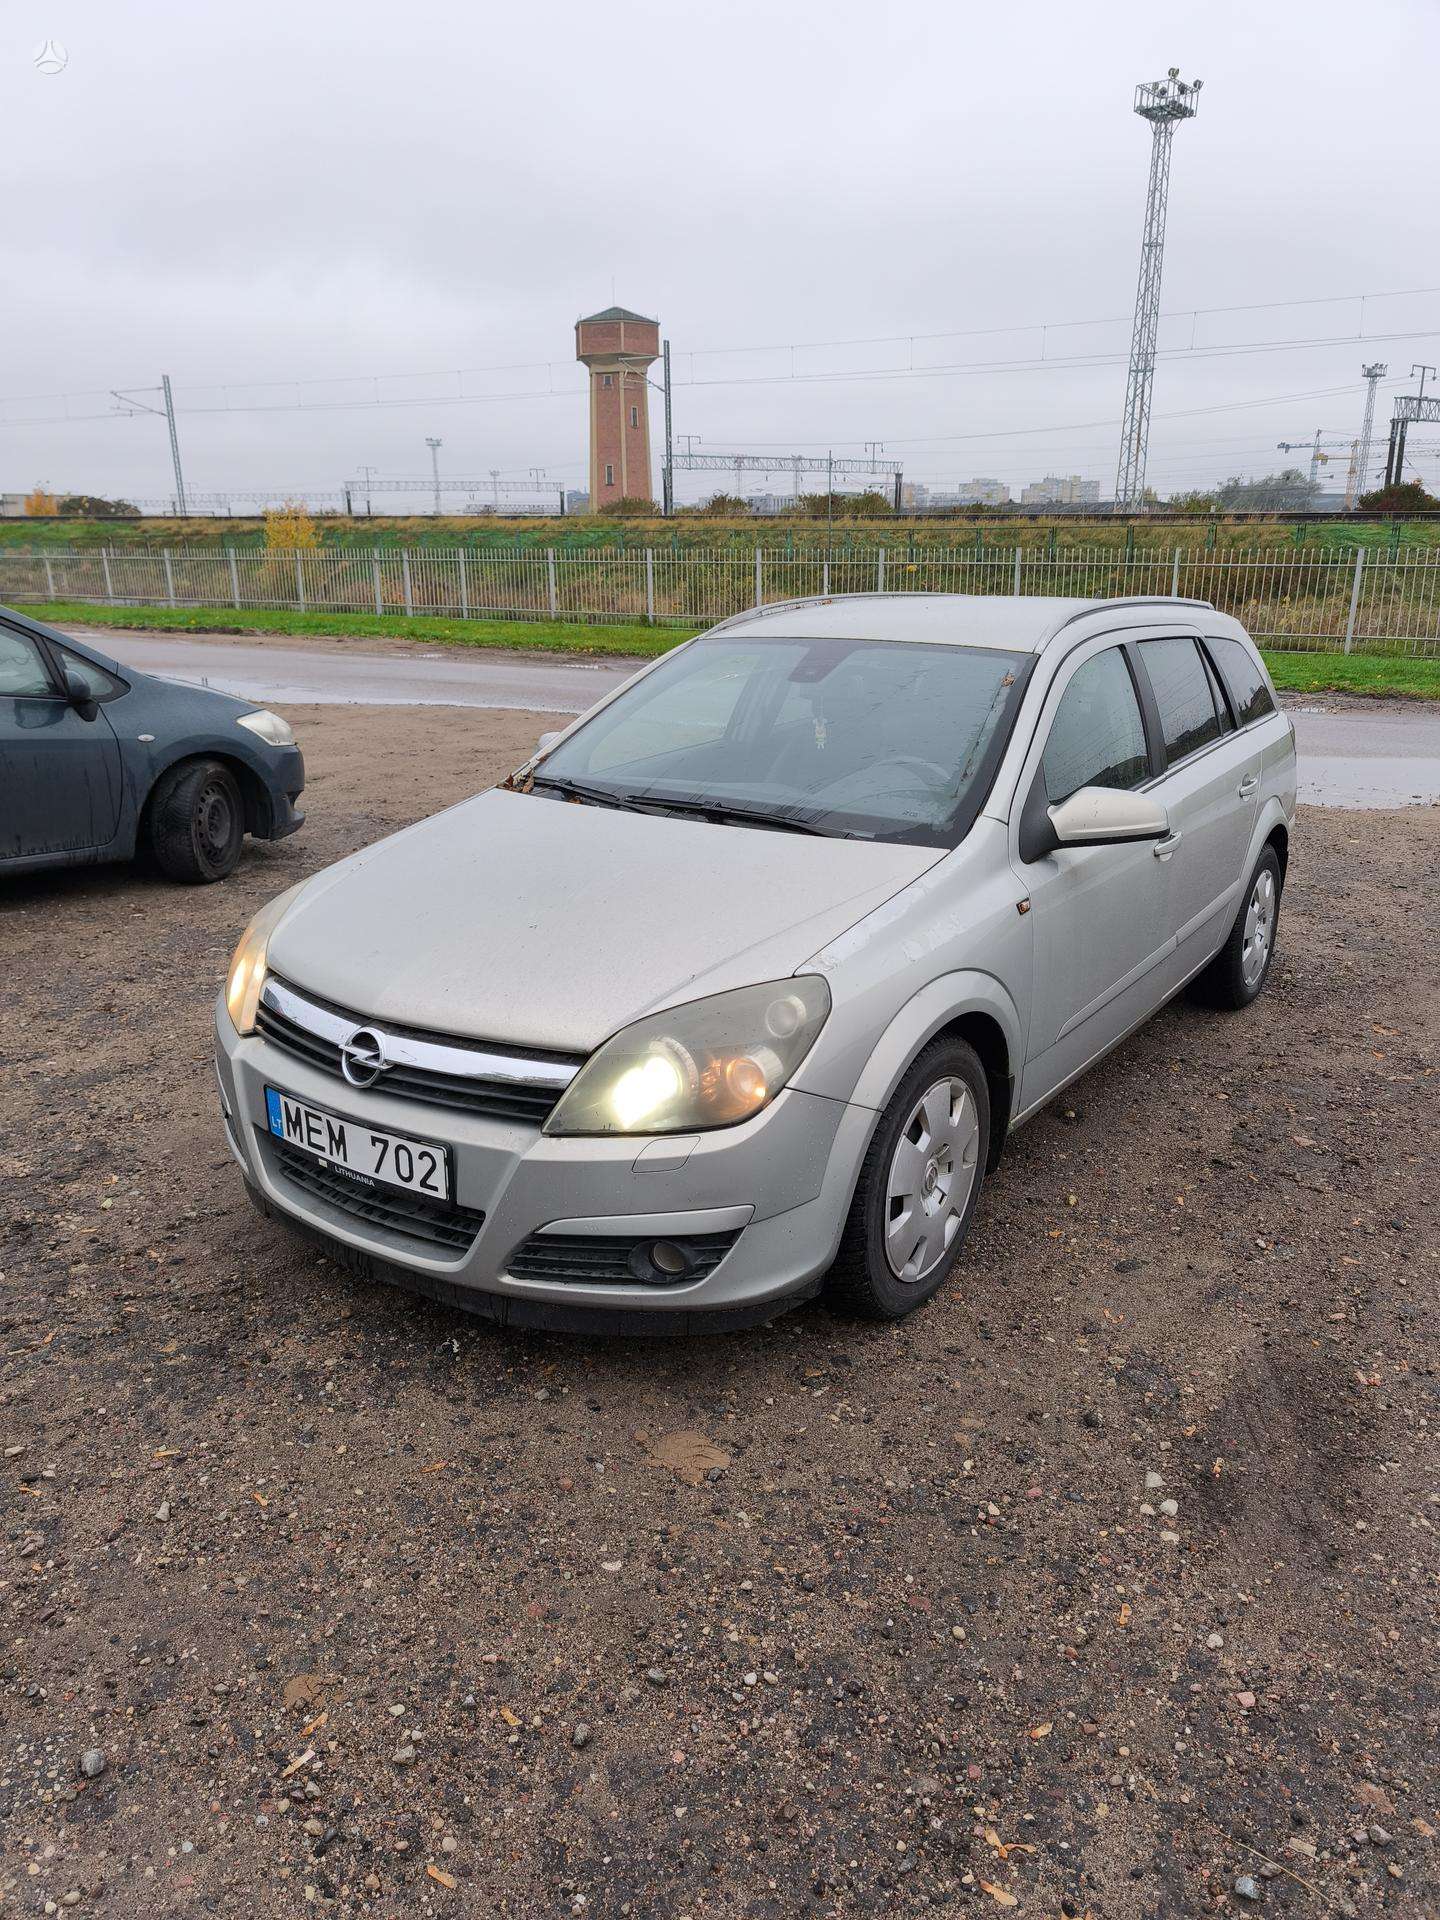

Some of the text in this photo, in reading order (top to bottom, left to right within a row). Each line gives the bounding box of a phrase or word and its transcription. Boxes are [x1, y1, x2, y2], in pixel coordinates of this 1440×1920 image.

[271, 1116, 283, 1128] LT
[284, 1101, 439, 1192] MEM 702
[334, 1165, 376, 1187] LITHUANIA
